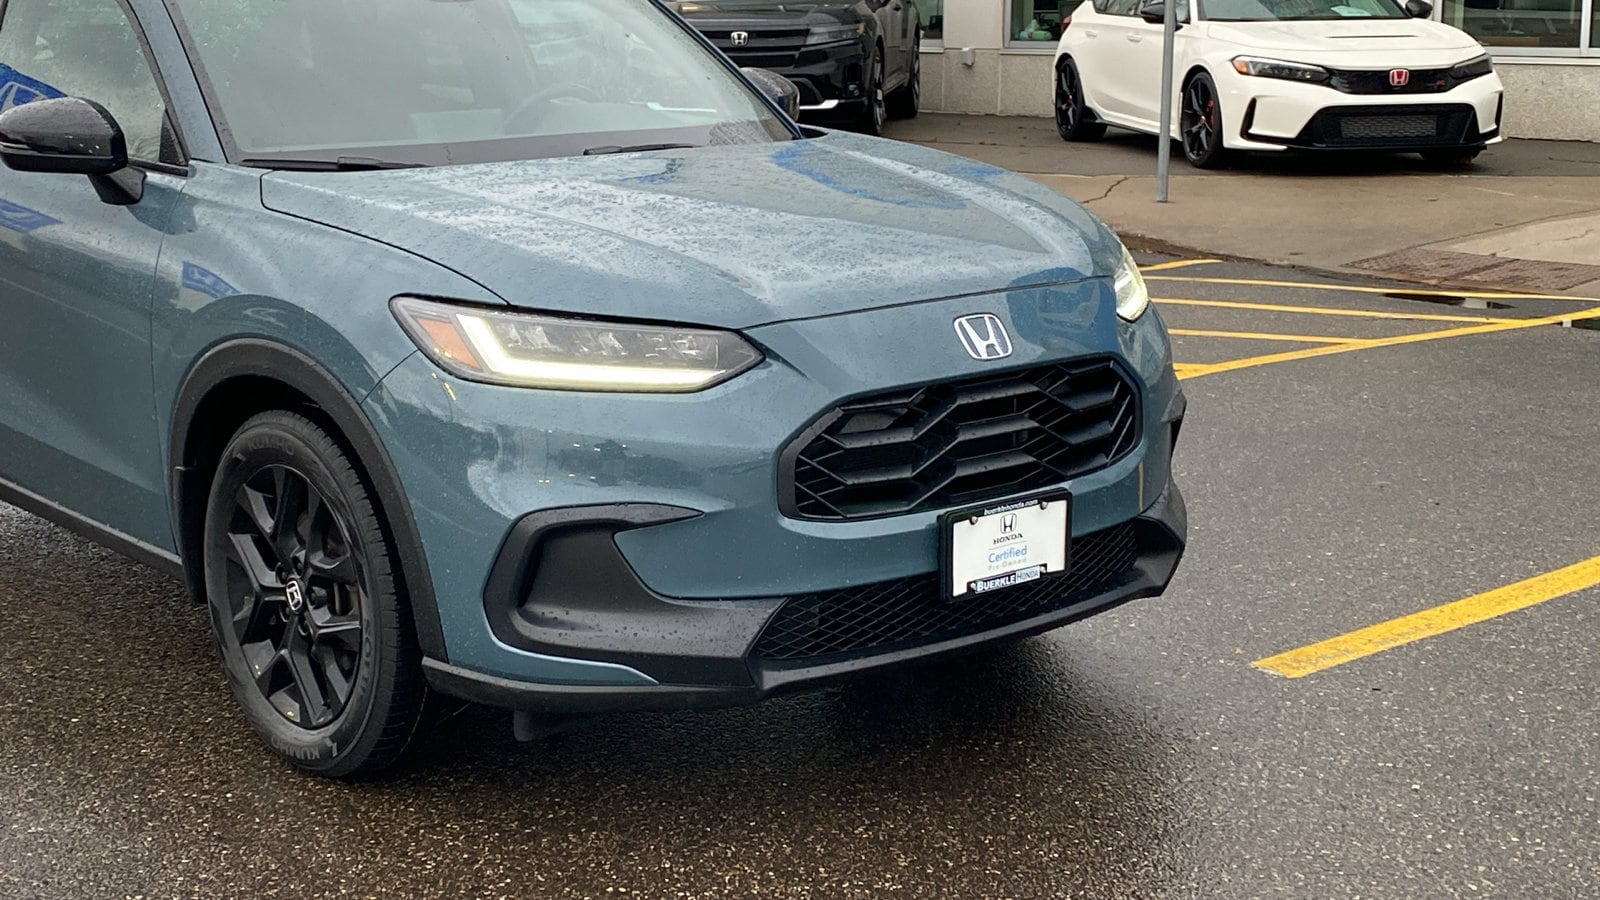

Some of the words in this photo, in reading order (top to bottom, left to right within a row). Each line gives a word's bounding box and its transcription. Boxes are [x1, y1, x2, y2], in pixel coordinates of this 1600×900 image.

[993, 532, 1023, 545] HONDA
[988, 545, 1027, 563] Certified
[976, 575, 1016, 592] BUERKLE
